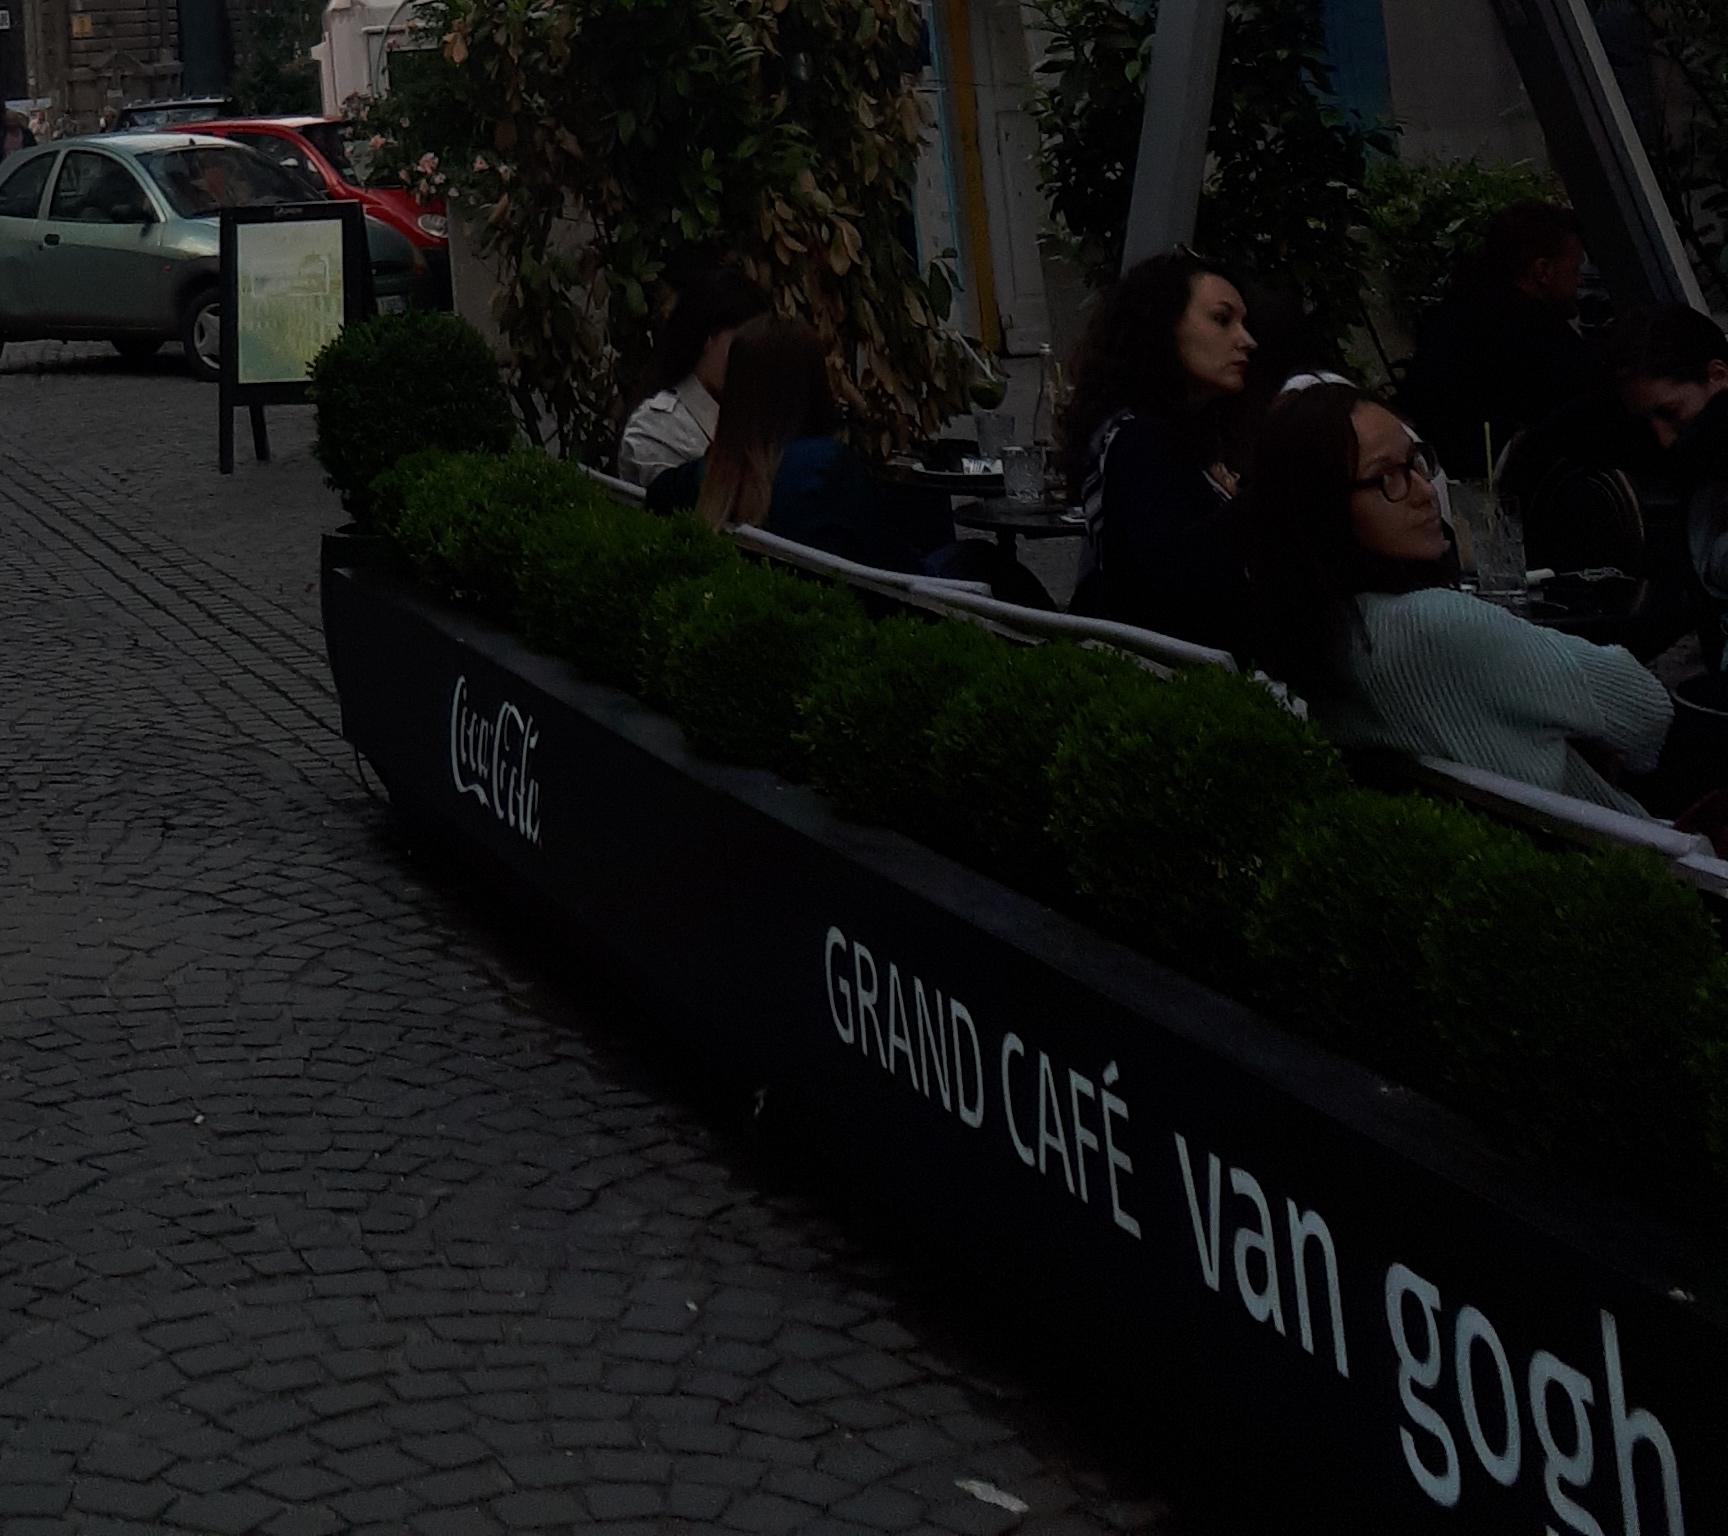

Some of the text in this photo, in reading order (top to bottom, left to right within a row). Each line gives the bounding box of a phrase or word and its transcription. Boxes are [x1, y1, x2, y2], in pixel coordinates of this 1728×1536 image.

[450, 673, 541, 845] Coca-Cola
[824, 925, 1685, 1536] GRAND CAFÉ van gogh
